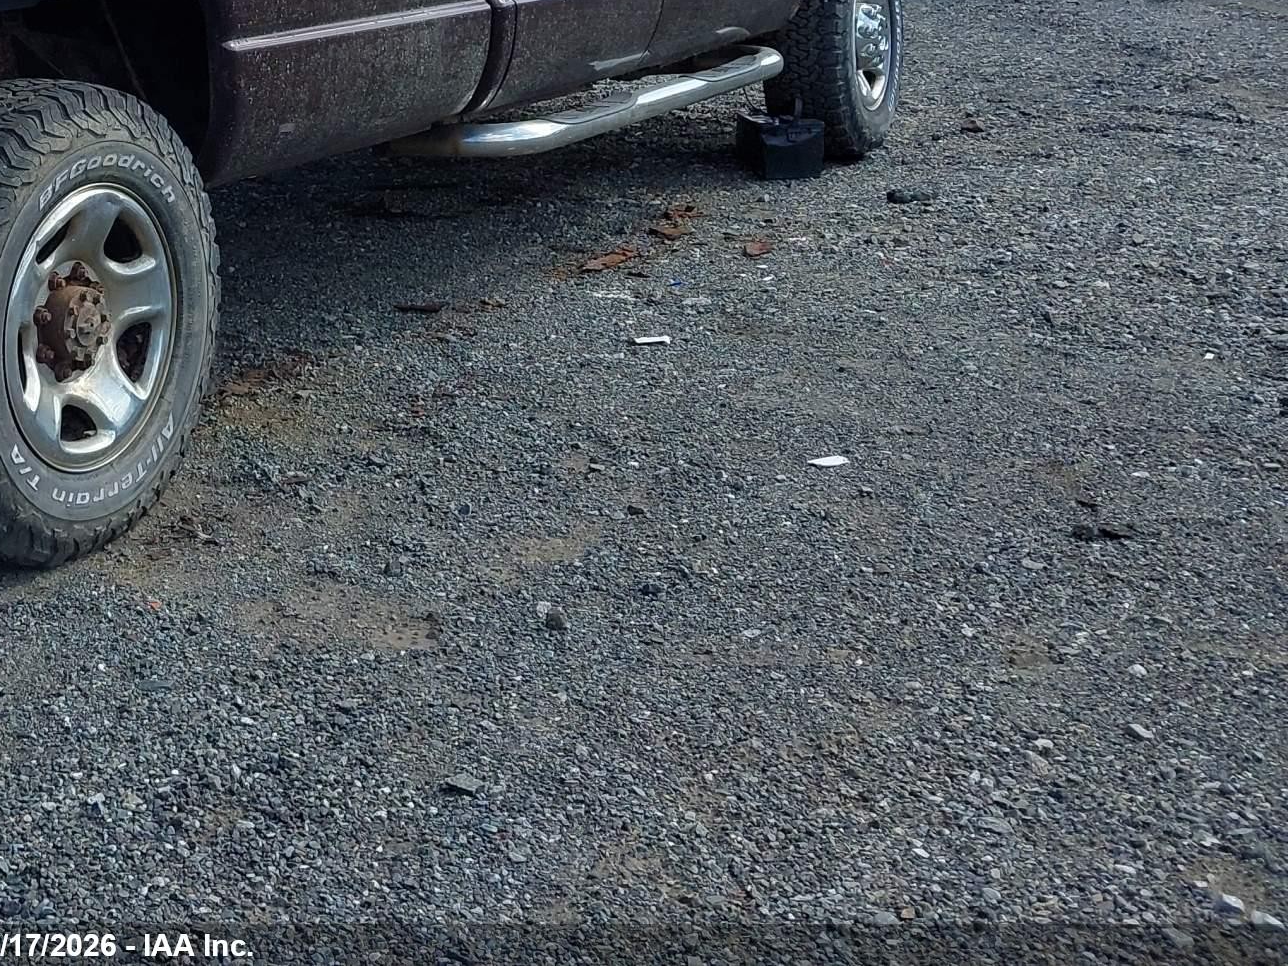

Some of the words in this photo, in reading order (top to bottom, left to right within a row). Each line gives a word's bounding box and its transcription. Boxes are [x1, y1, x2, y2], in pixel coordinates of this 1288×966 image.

[39, 153, 177, 212] BFGoodrich
[11, 444, 41, 491] T/A
[52, 411, 175, 507] All-Terrain
